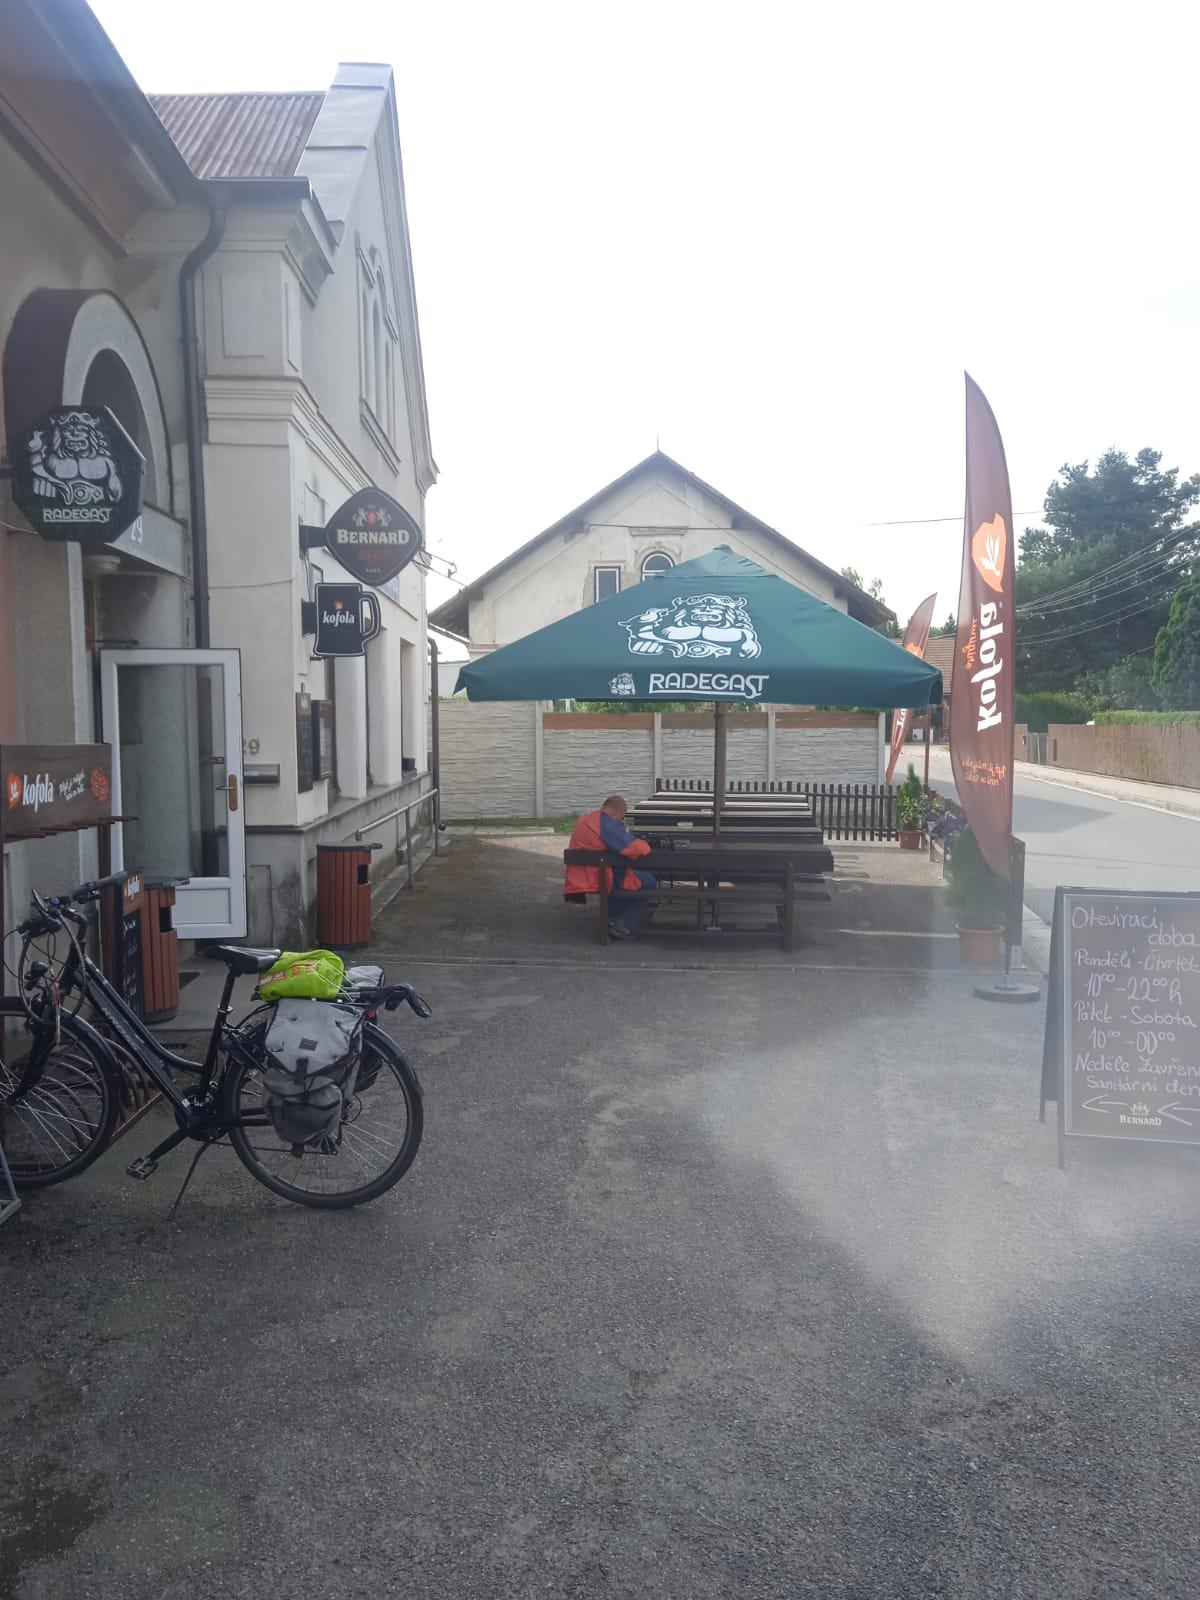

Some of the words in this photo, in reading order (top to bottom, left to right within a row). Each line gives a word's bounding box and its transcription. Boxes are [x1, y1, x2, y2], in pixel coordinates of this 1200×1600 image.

[43, 508, 112, 523] RADEGAST
[337, 529, 409, 544] BERNARD
[323, 611, 355, 627] kofola
[649, 673, 769, 699] RADEGAST
[22, 773, 55, 812] kofola
[1148, 921, 1200, 947] doba
[1130, 1006, 1197, 1028] Sobota
[1138, 1055, 1200, 1077] Zavřen
[1120, 1114, 1162, 1126] BERNARD
